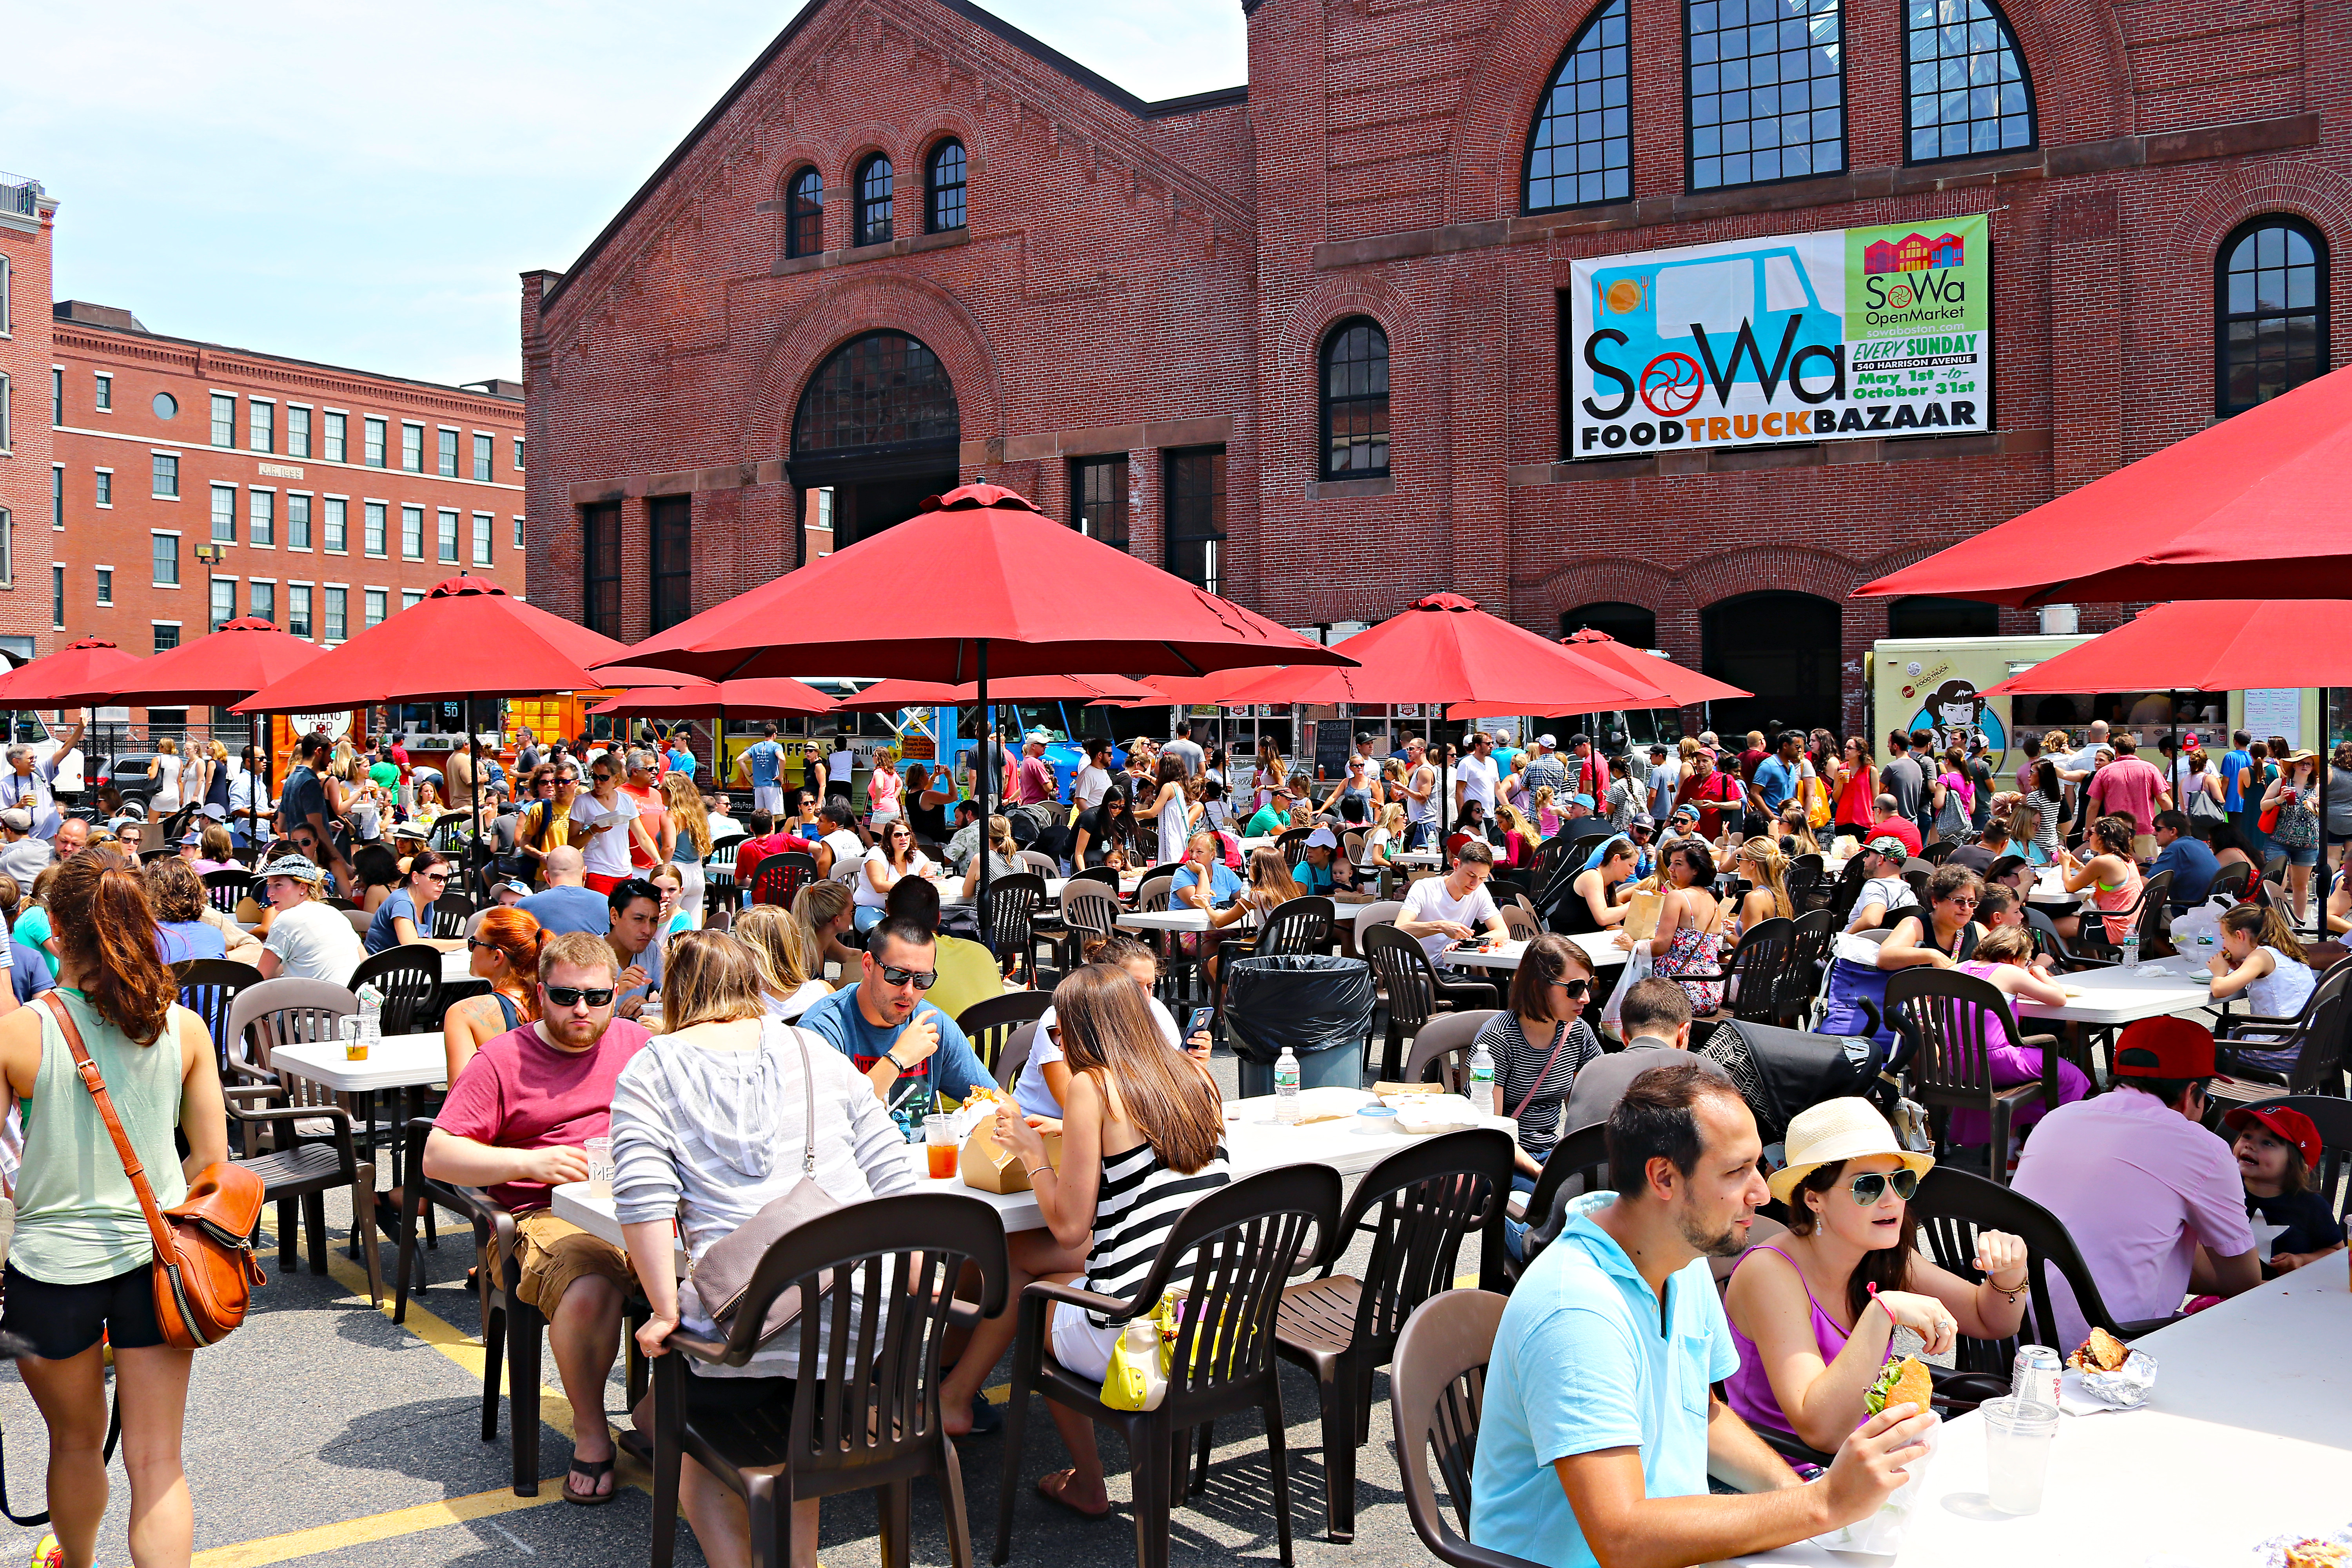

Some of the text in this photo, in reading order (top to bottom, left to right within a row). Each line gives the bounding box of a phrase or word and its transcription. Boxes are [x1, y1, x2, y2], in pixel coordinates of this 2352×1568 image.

[1865, 269, 1965, 310] SoWa
[1866, 306, 1964, 327] OpenMarket
[1867, 323, 1964, 338] sowaboston.com
[1853, 334, 1977, 361] EVERY SUNDAY
[1582, 314, 1844, 420] SoWa
[1877, 359, 1928, 369] HARRISON
[1931, 356, 1971, 365] AVENUE
[1858, 373, 1900, 385] May
[1909, 370, 1934, 381] 1st
[1853, 381, 1975, 399] October 31st
[262, 466, 301, 478] J.R. 1895
[1916, 665, 1949, 688] FOOD TRUCK
[444, 706, 458, 717] 50
